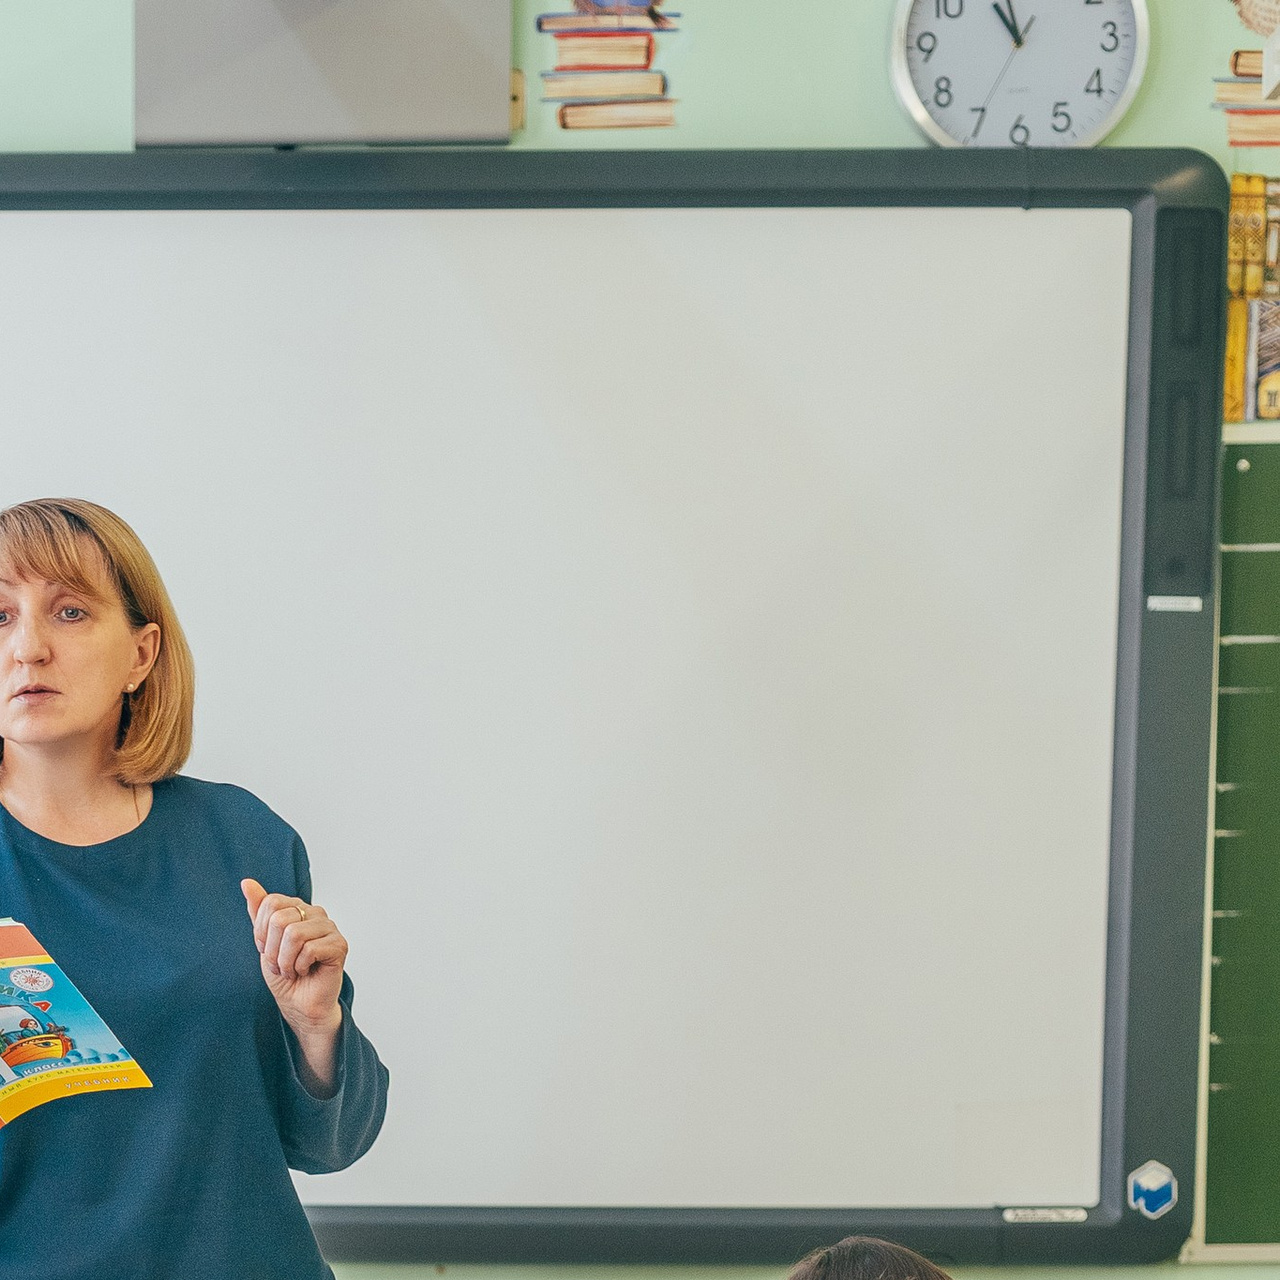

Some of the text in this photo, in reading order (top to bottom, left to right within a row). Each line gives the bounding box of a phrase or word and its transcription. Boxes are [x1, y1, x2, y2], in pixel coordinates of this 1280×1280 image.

[917, 31, 936, 62] 9
[1100, 21, 1119, 52] 3
[934, 76, 952, 108] 8
[1085, 67, 1103, 97] 4
[969, 107, 986, 138] 7
[1009, 114, 1030, 146] 6
[1051, 101, 1072, 133] 5
[22, 1061, 64, 1077] класс
[26, 1072, 52, 1084] КУРС
[57, 1063, 122, 1075] МАТЕМАТИКИ
[64, 1077, 131, 1089] УЧЕБНИК
